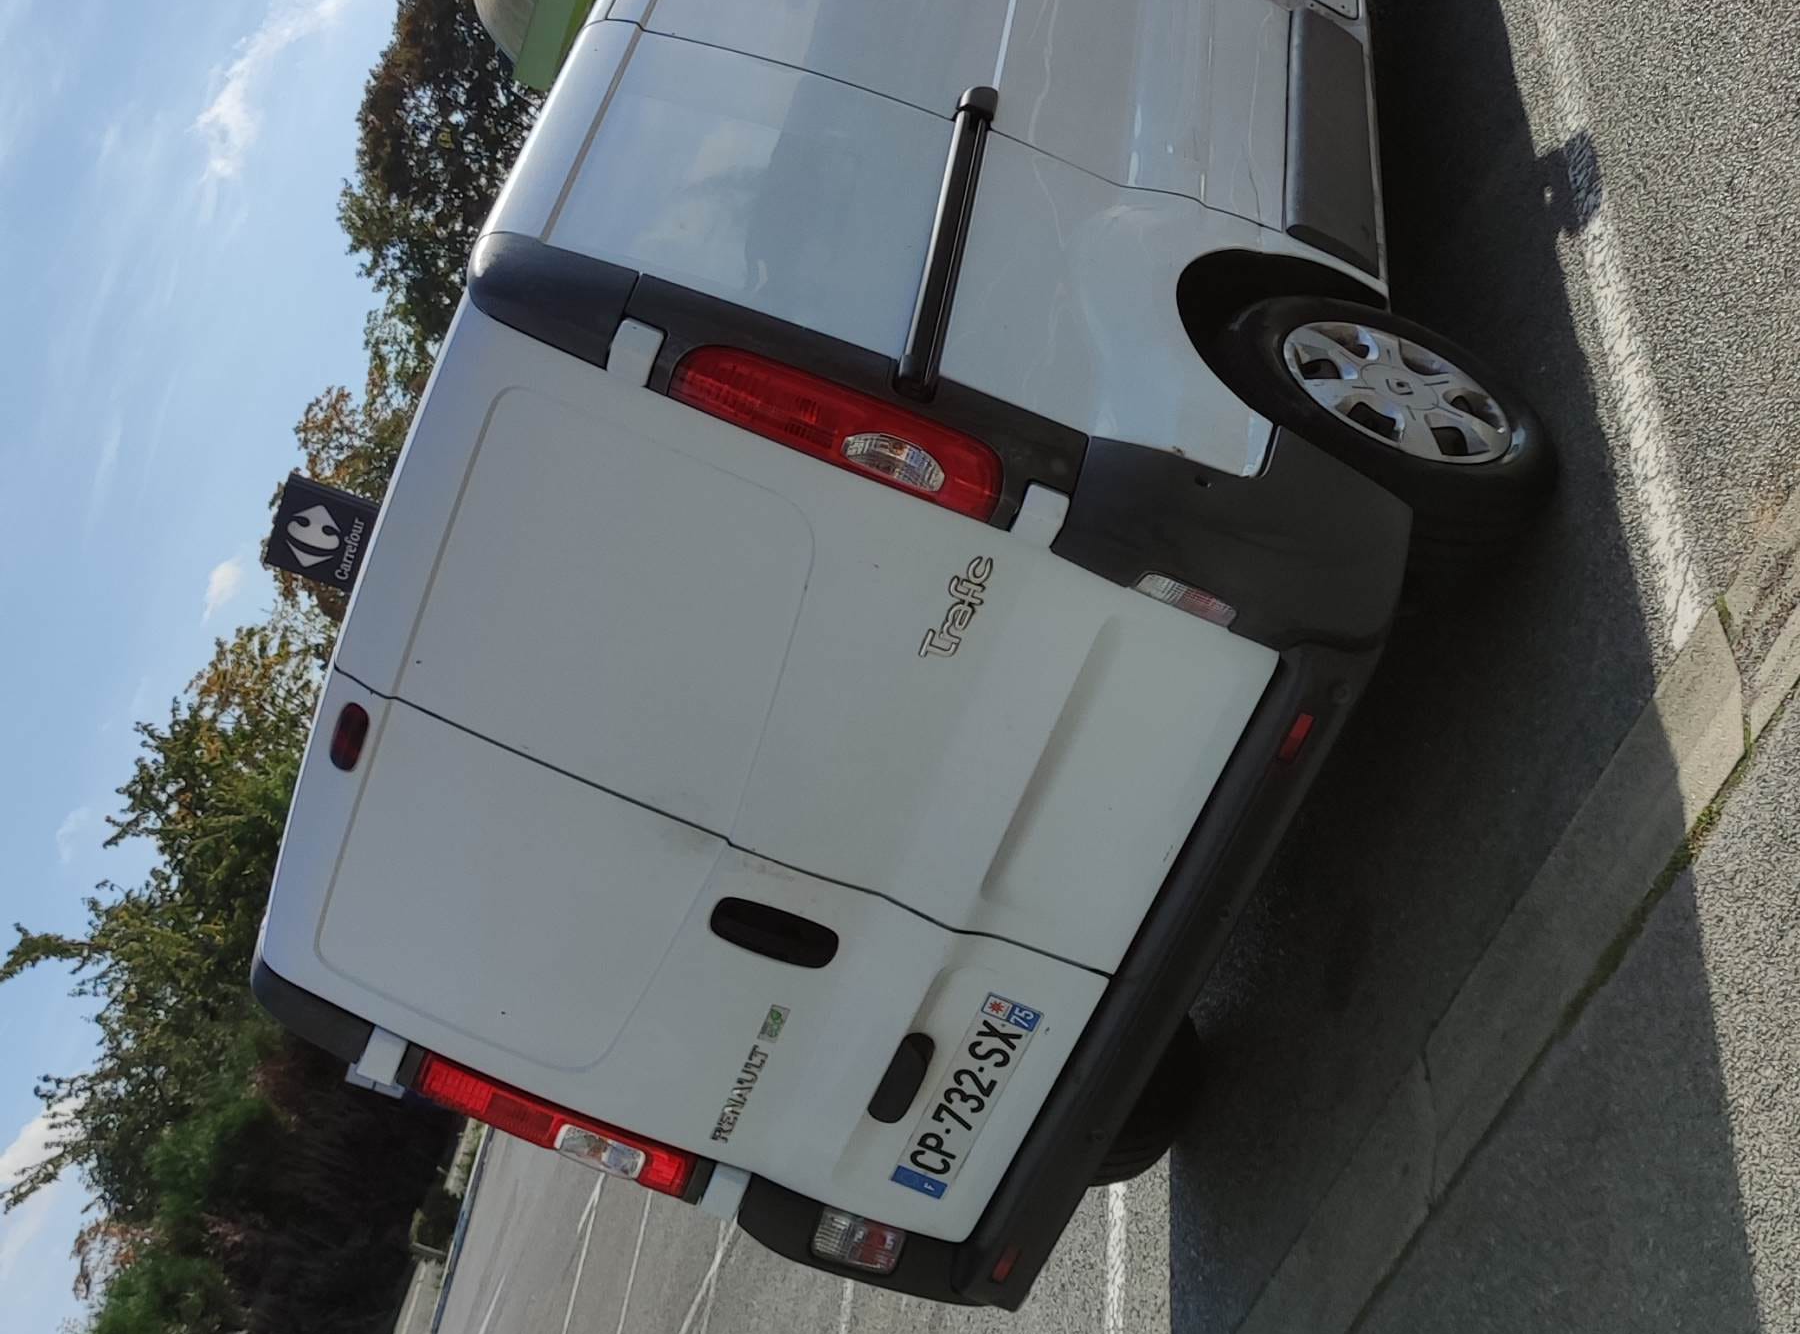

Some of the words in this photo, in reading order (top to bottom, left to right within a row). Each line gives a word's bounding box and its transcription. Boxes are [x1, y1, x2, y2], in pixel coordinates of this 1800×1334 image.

[335, 517, 365, 580] Carrefour
[918, 556, 993, 658] Trafic
[1010, 1006, 1034, 1028] 75
[711, 1044, 769, 1143] RENAULT
[910, 1020, 1023, 1175] CP-732-SX
[924, 1182, 934, 1191] F
